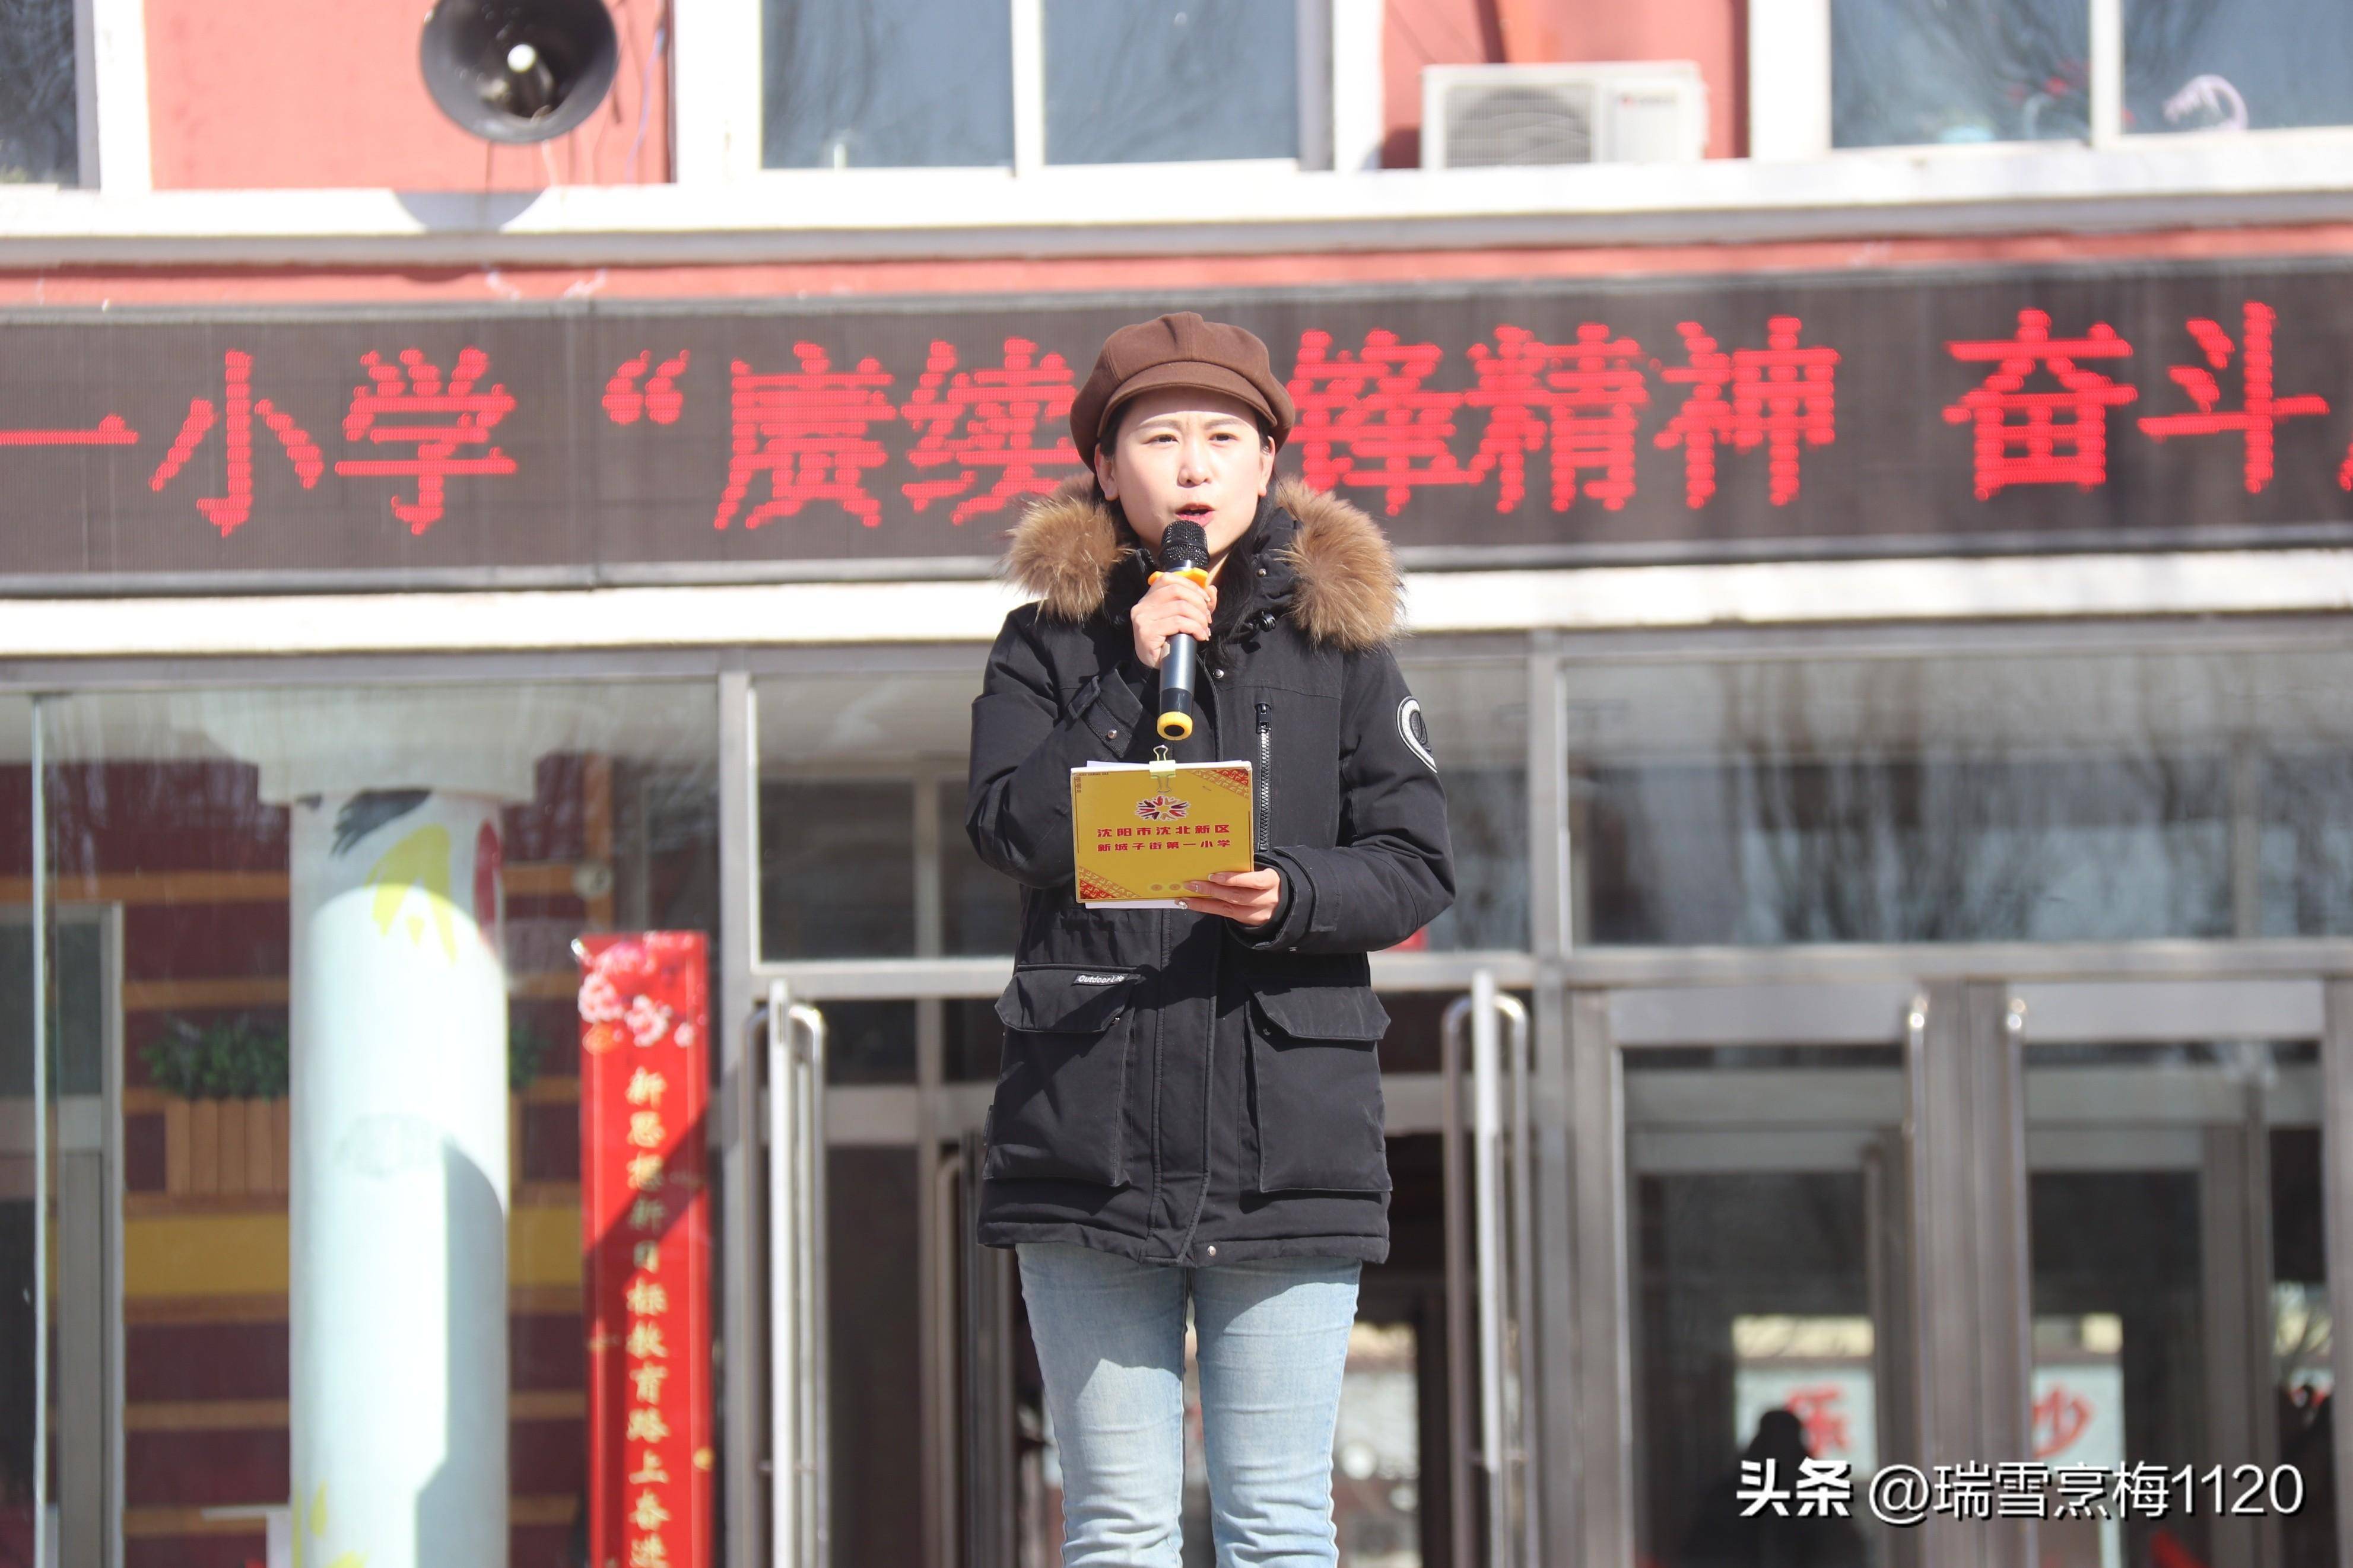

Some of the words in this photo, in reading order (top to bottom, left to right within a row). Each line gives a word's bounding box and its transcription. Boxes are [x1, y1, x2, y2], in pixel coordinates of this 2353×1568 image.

[1943, 302, 2353, 499] 奋斗
[1097, 824, 1230, 837] 沈阳市沈北新区
[1097, 839, 1230, 852] 新城子街第一小学
